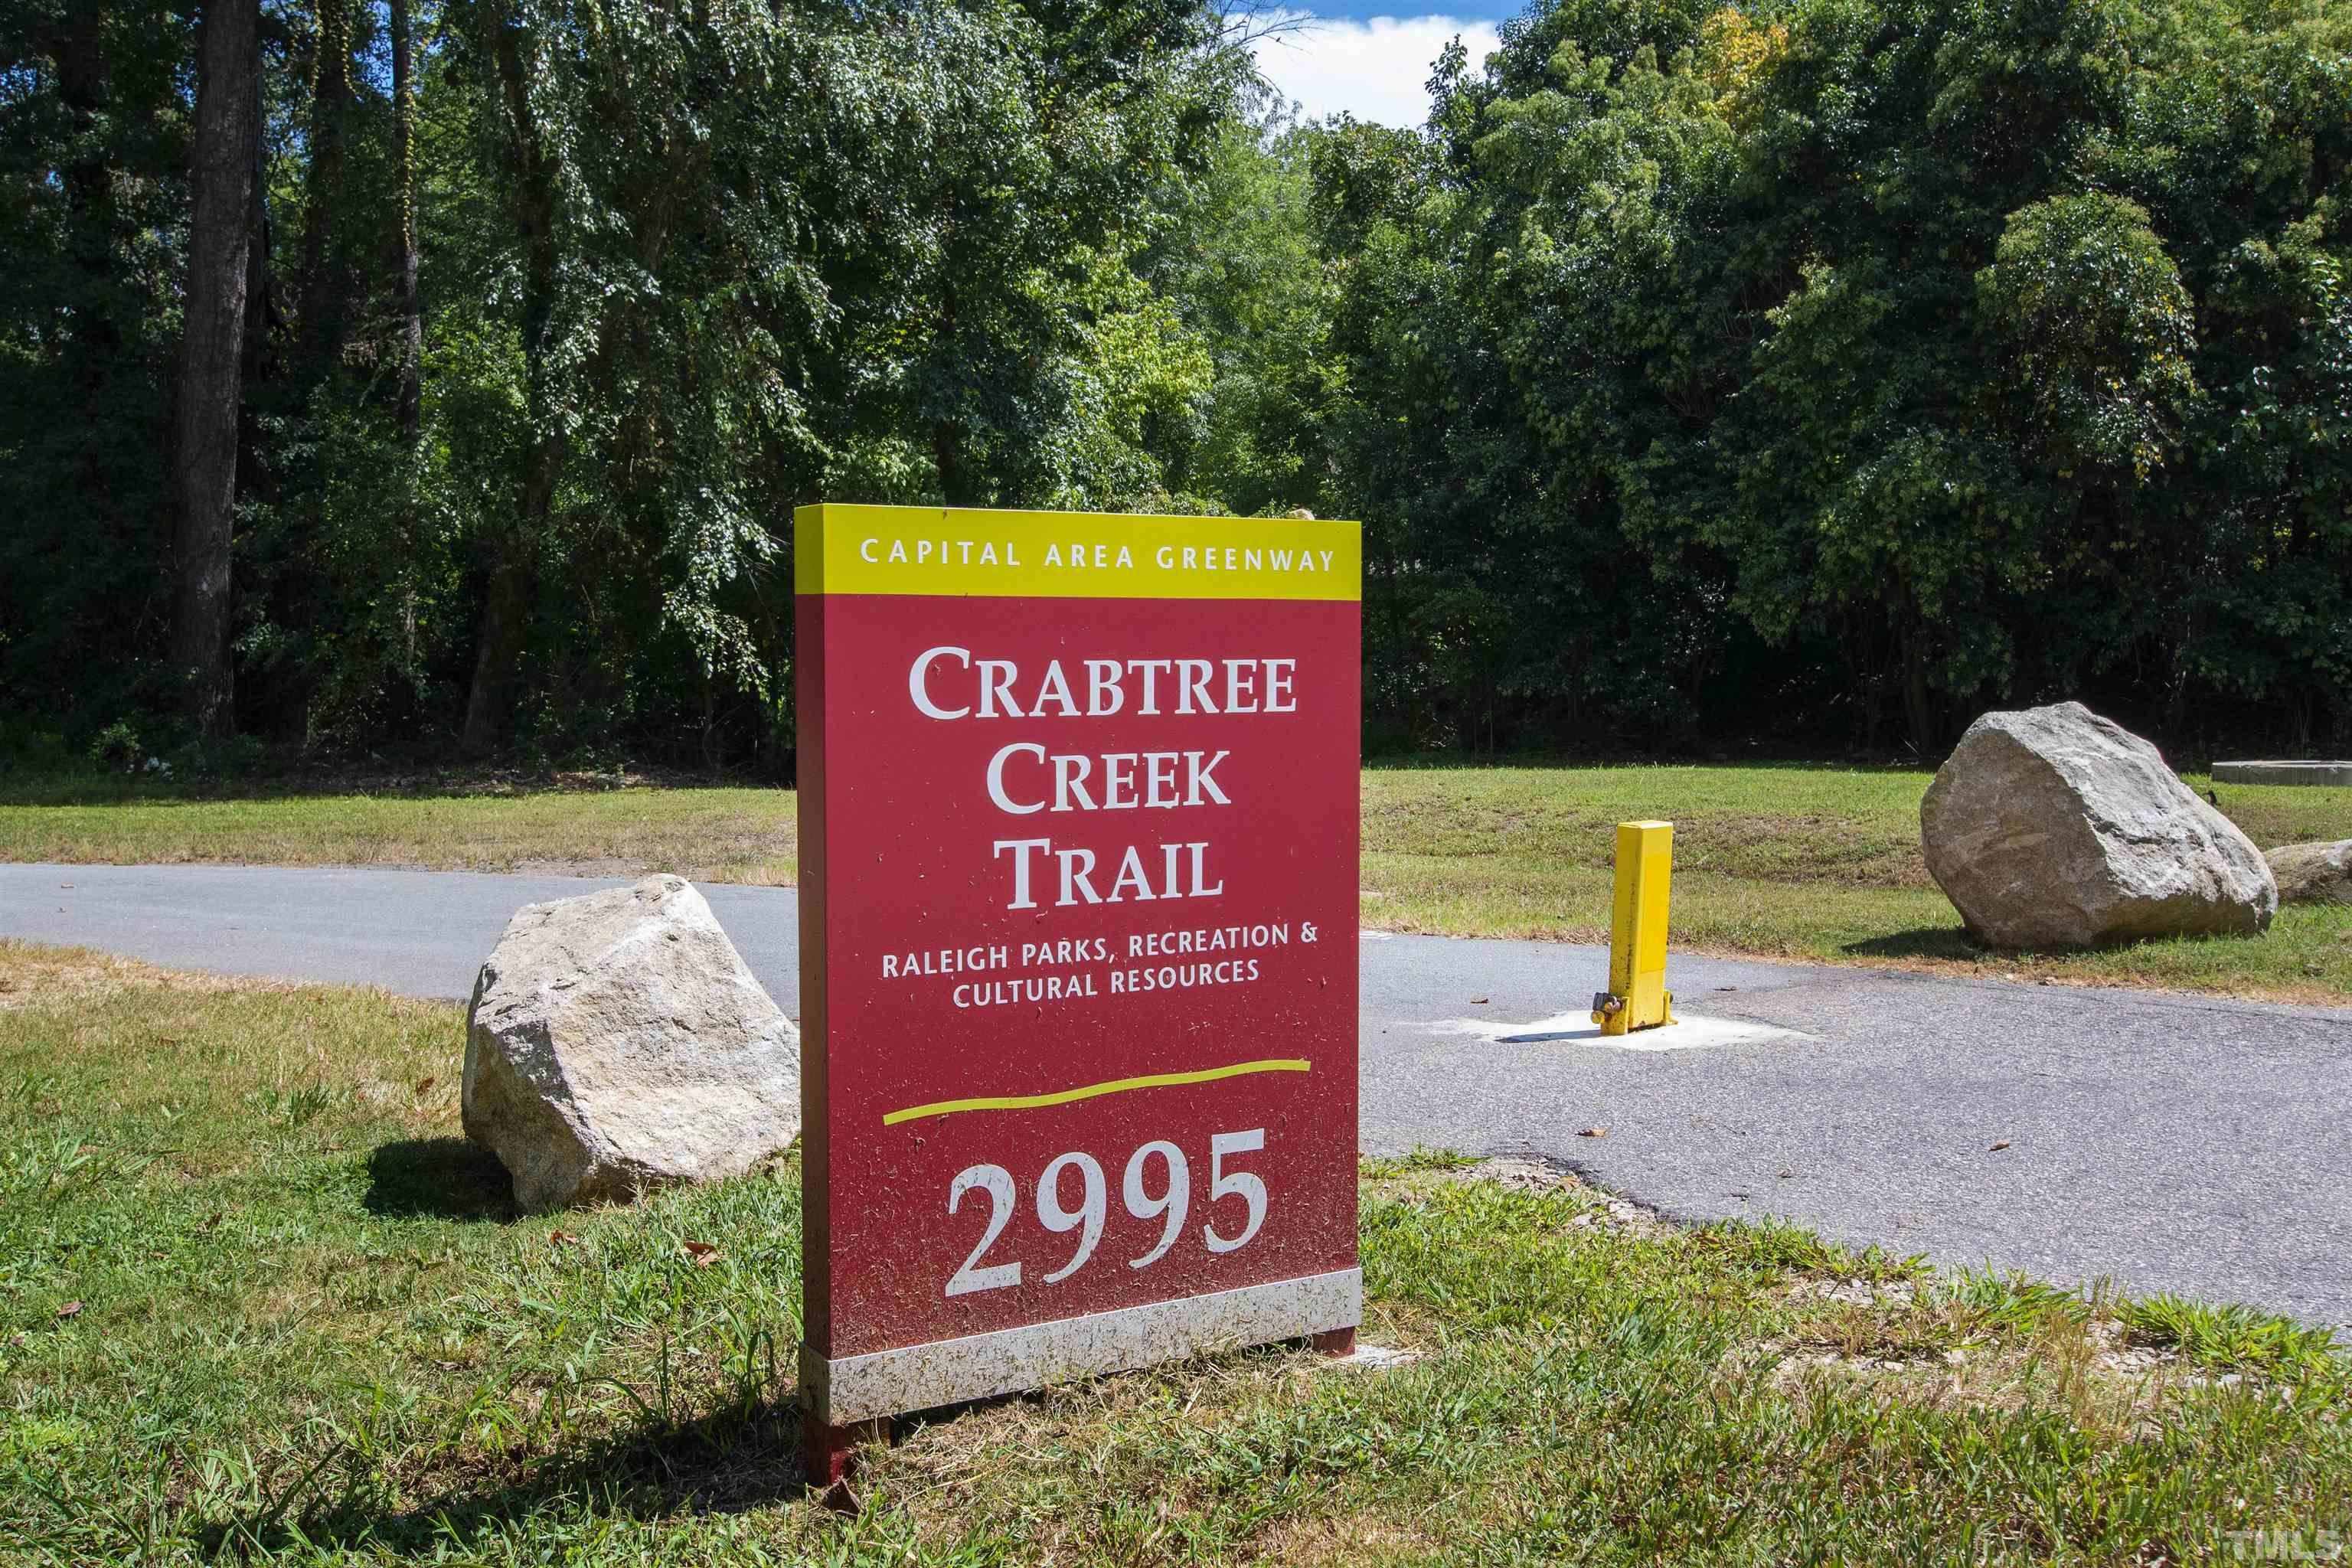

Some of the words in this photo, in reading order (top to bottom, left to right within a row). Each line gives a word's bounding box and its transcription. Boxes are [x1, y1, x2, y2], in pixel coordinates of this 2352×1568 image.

[860, 537, 1021, 567] CAPITAL
[1044, 543, 1133, 568] AREA
[1155, 545, 1334, 573] GREENWAY
[909, 646, 1297, 720] CRABTREE
[986, 742, 1232, 815] CREEK
[993, 838, 1223, 910] TRAIL
[882, 946, 1008, 978] RALEIGH
[1021, 937, 1116, 968] PARKS,
[1129, 923, 1289, 958] RECREATION
[1300, 921, 1318, 943] &
[952, 973, 1098, 1008] CULTURAL
[1108, 959, 1259, 994] RESOURCES
[945, 1127, 1268, 1297] 2995
